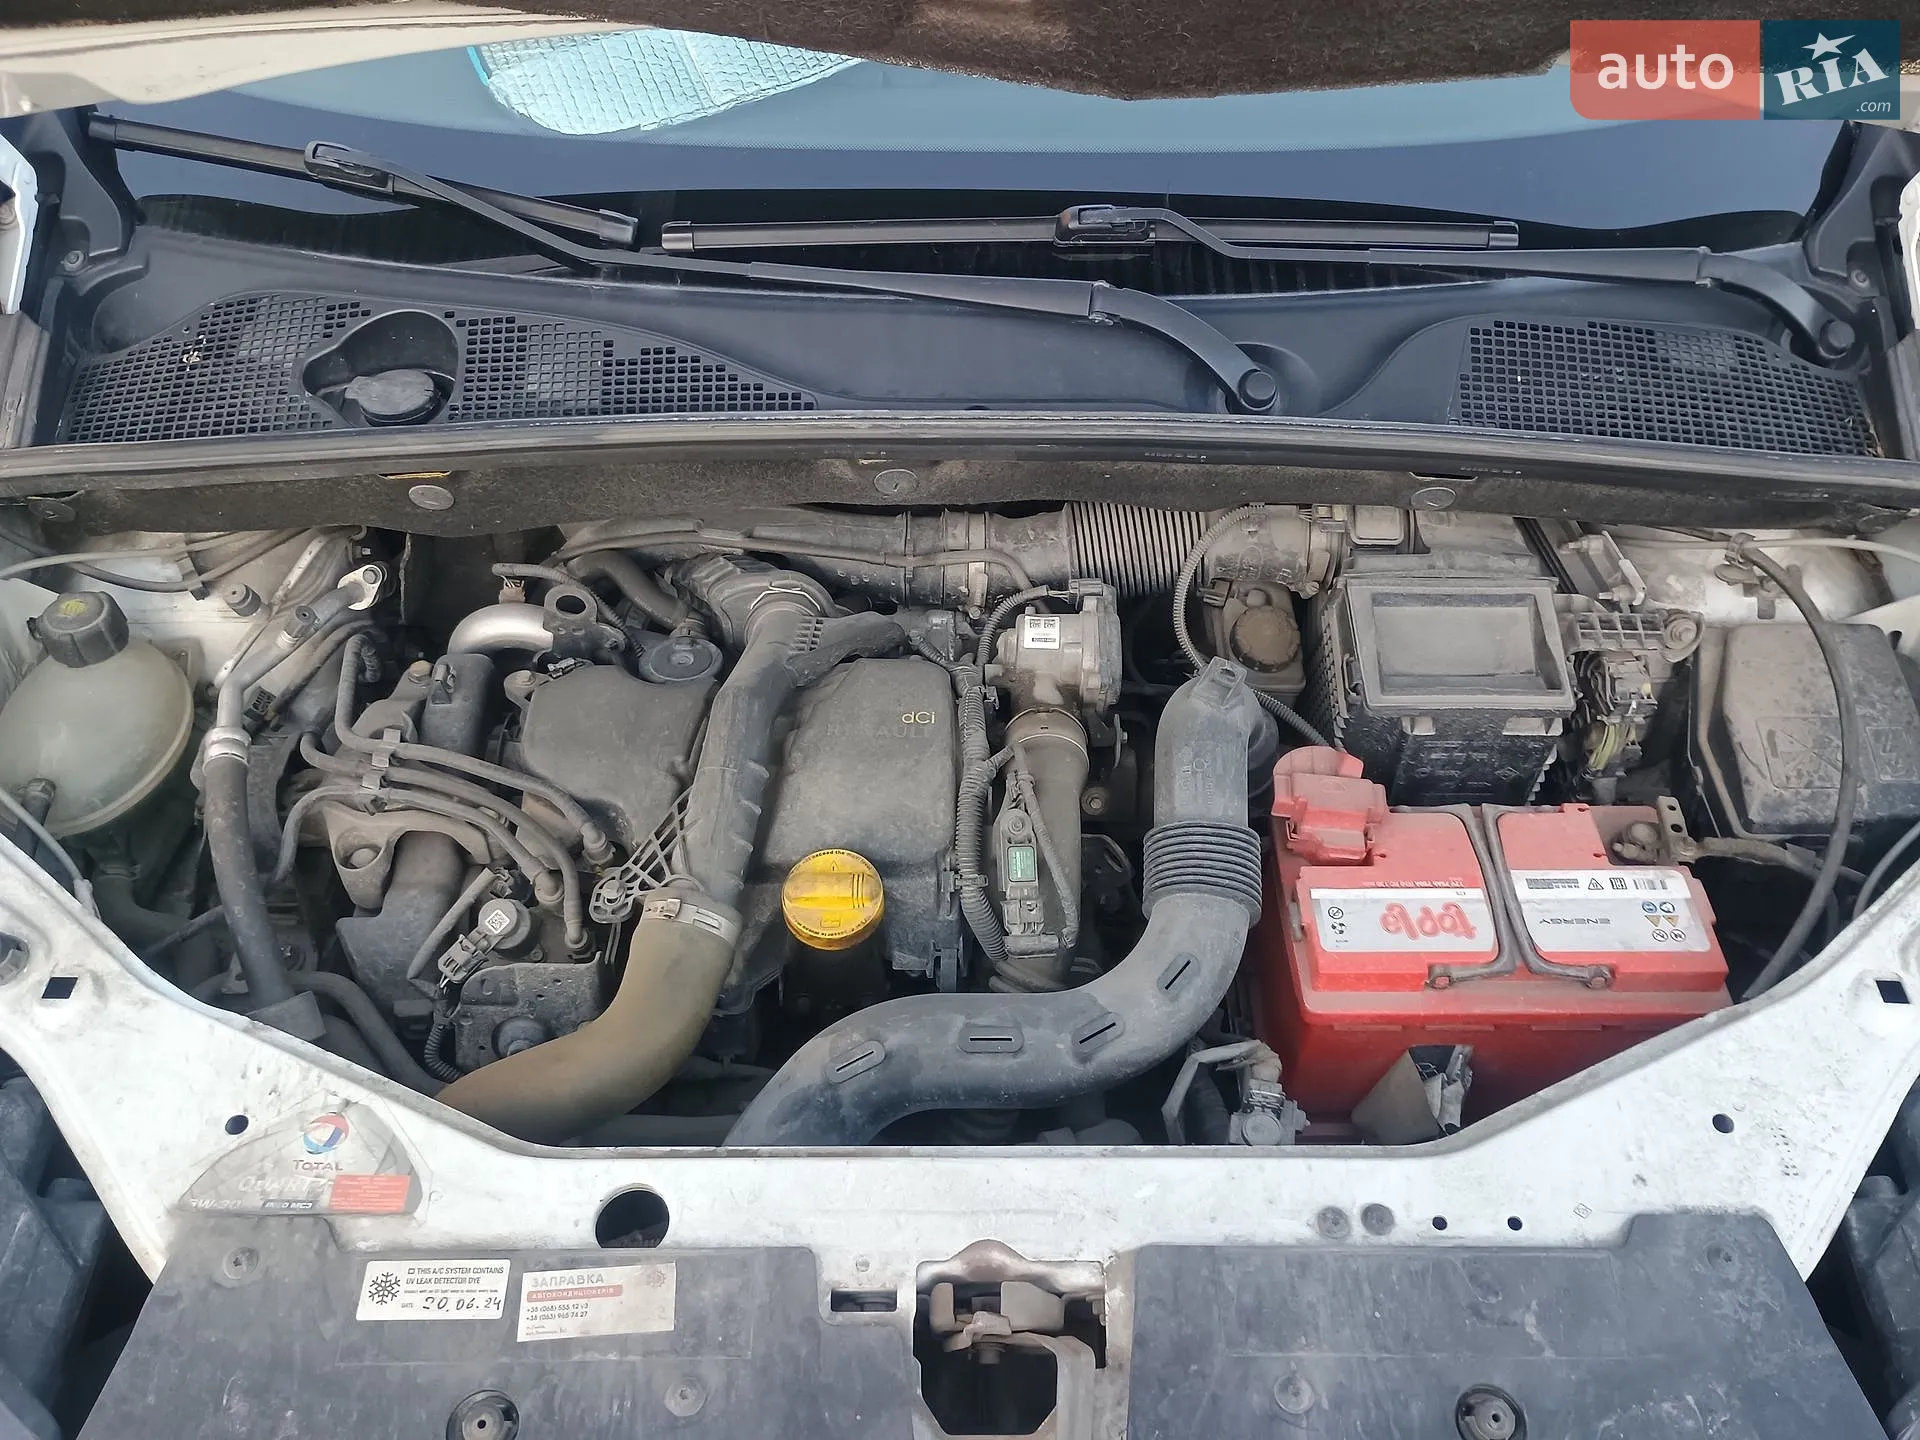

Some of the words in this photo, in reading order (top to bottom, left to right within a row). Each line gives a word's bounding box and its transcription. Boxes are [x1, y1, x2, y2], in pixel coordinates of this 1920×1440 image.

[902, 711, 935, 724] dCi
[1540, 917, 1611, 925] ENERGY
[293, 1160, 344, 1171] TOTAL
[445, 1267, 471, 1275] SYSTEM
[532, 1273, 604, 1287] ЗАПРАВКА
